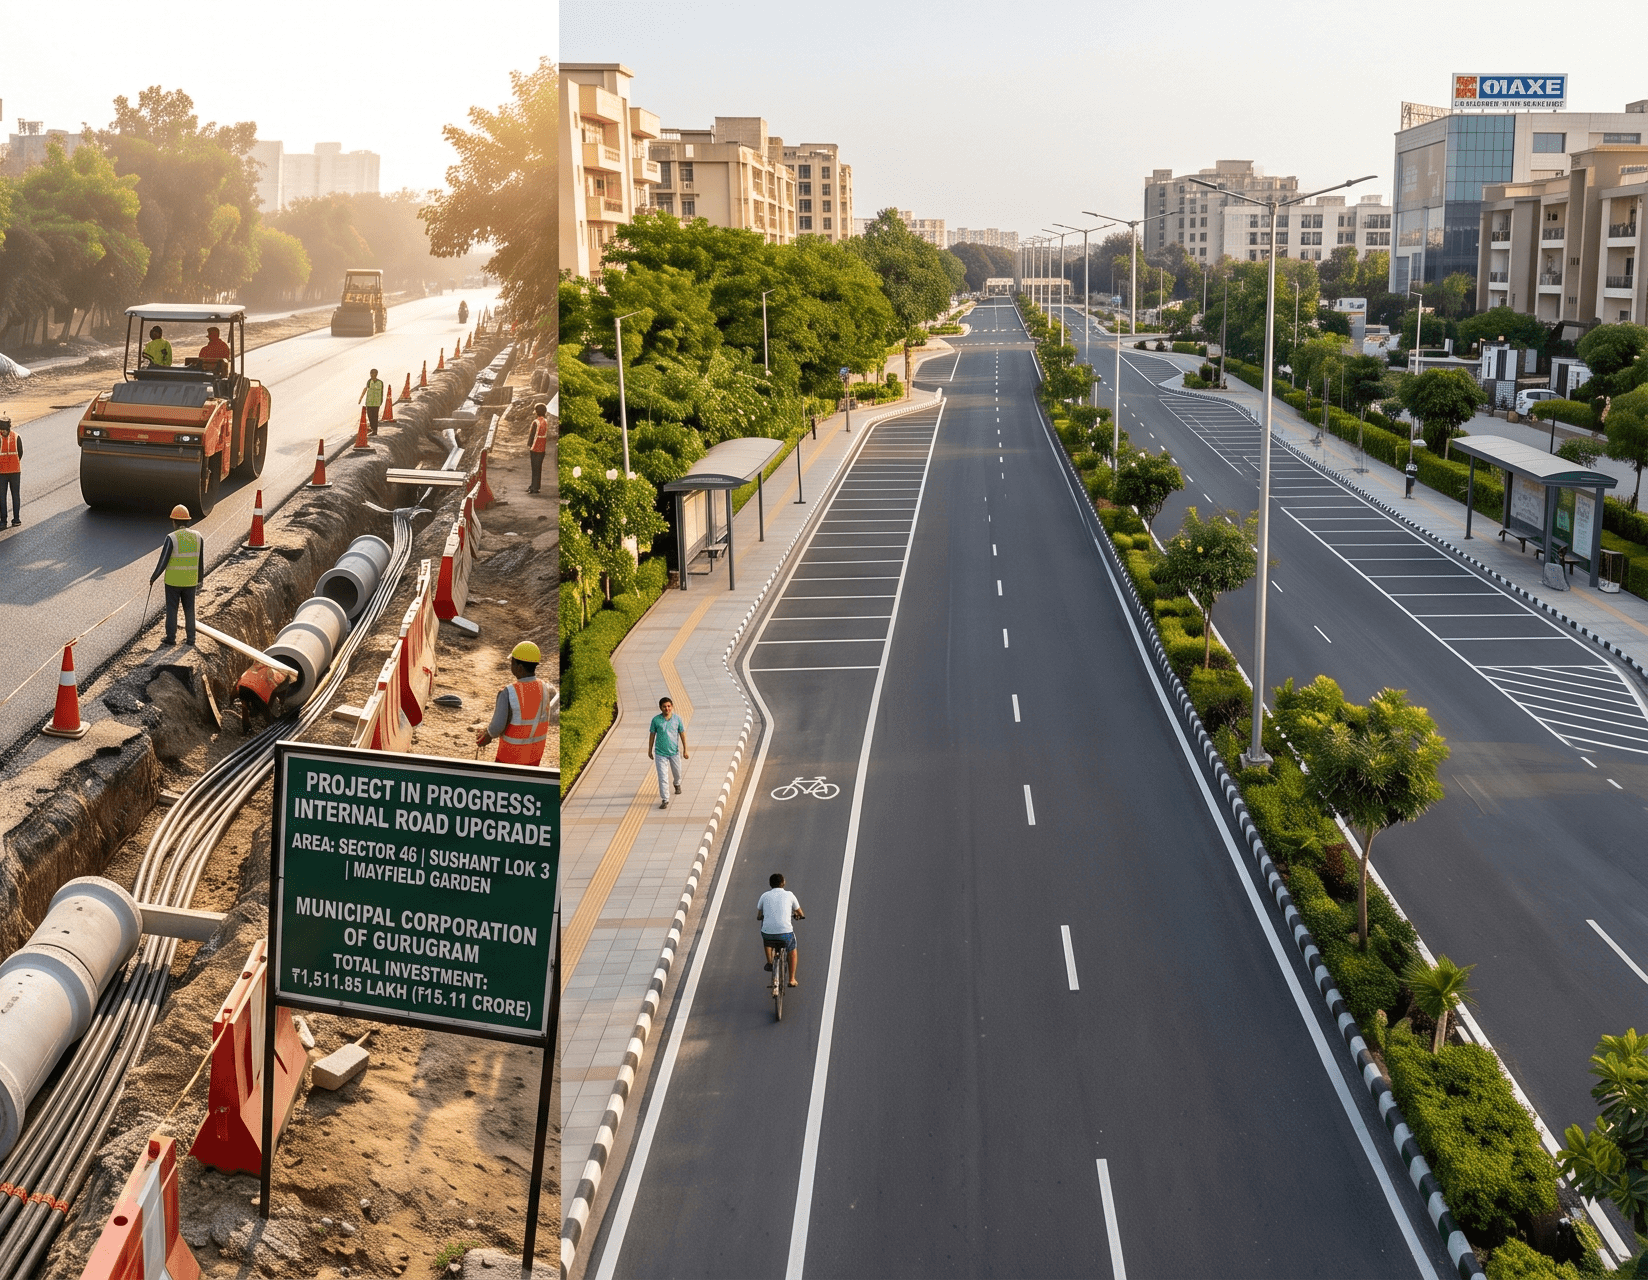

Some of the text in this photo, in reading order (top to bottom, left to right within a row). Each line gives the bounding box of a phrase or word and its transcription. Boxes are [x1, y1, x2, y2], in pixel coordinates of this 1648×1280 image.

[306, 771, 542, 817] PROJECT IN PROGRESS:
[294, 797, 552, 847] INTERNAL ROAD UPGRADE
[292, 832, 335, 853] AREA:
[338, 838, 396, 861] SECTOR
[399, 845, 417, 863] 46
[429, 849, 501, 874] SUSHANT
[504, 858, 536, 878] LOK
[540, 862, 550, 880] 3
[353, 862, 425, 886] MAYFIELD
[429, 870, 491, 894] GARDEN
[296, 896, 538, 947] MUNICIPAL CORPORATION
[343, 927, 480, 963] OF GURUGRAM
[333, 953, 488, 990] TOTAL INVESTMENT:
[366, 979, 407, 1001] LAKH
[472, 994, 531, 1022] CRORE)
